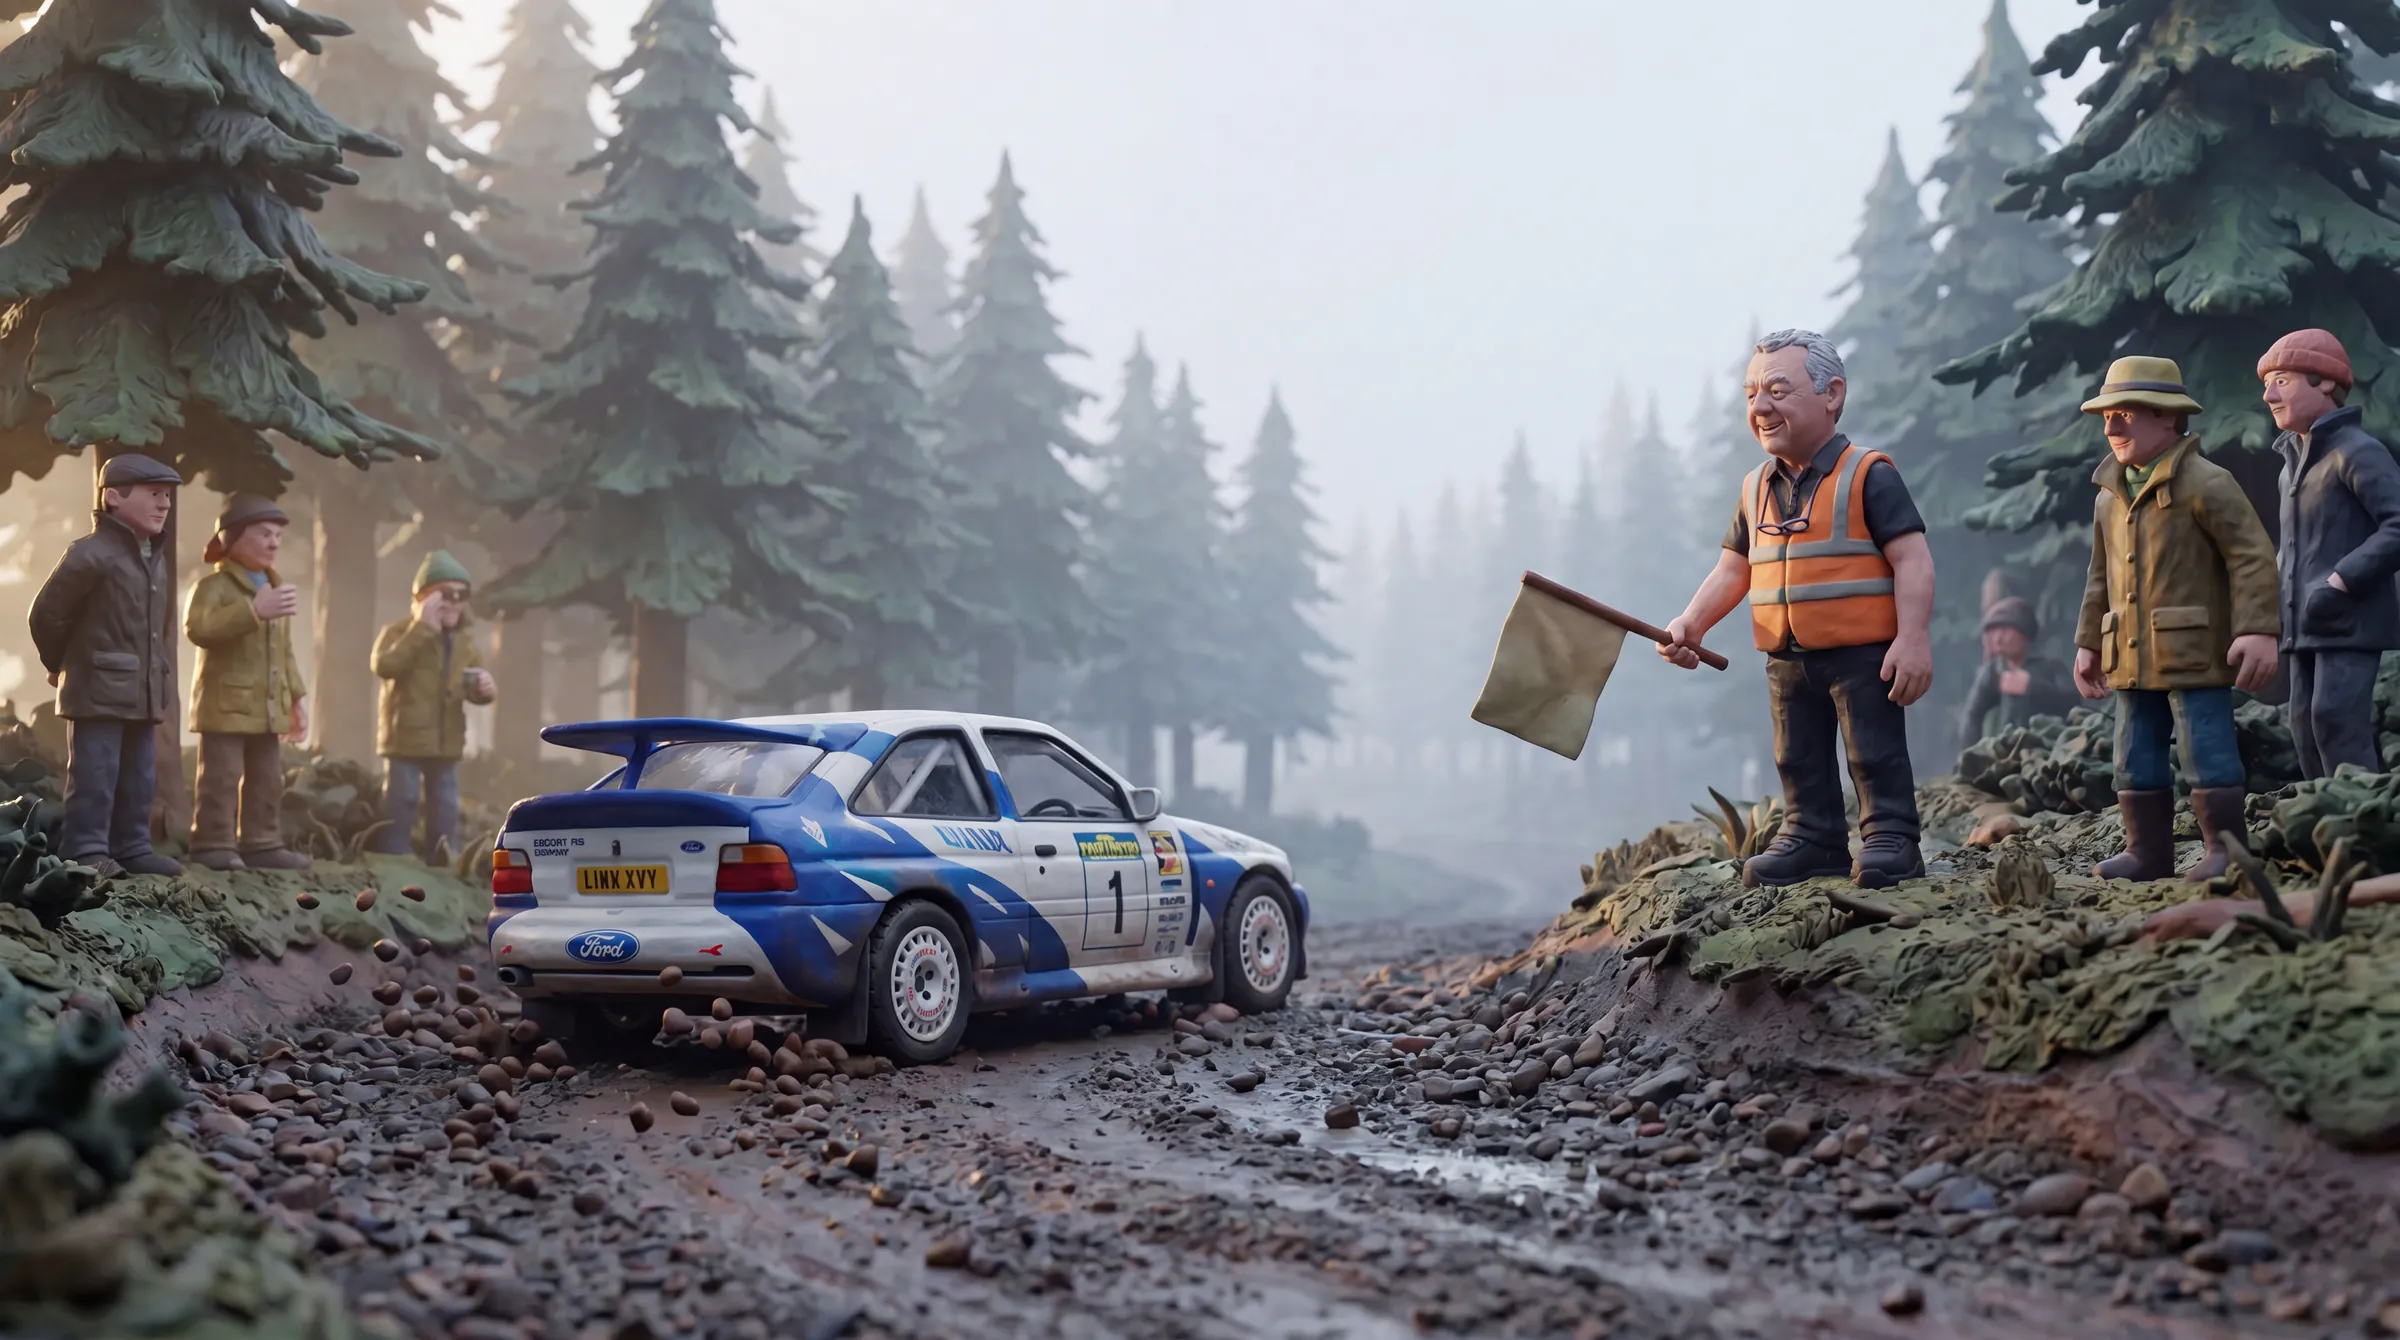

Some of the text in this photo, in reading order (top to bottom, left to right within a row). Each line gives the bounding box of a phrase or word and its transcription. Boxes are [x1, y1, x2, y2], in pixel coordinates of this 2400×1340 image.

[571, 838, 584, 846] RS
[584, 869, 656, 889] LINX XVY
[1109, 870, 1123, 934] 1
[580, 934, 625, 957] Ford
